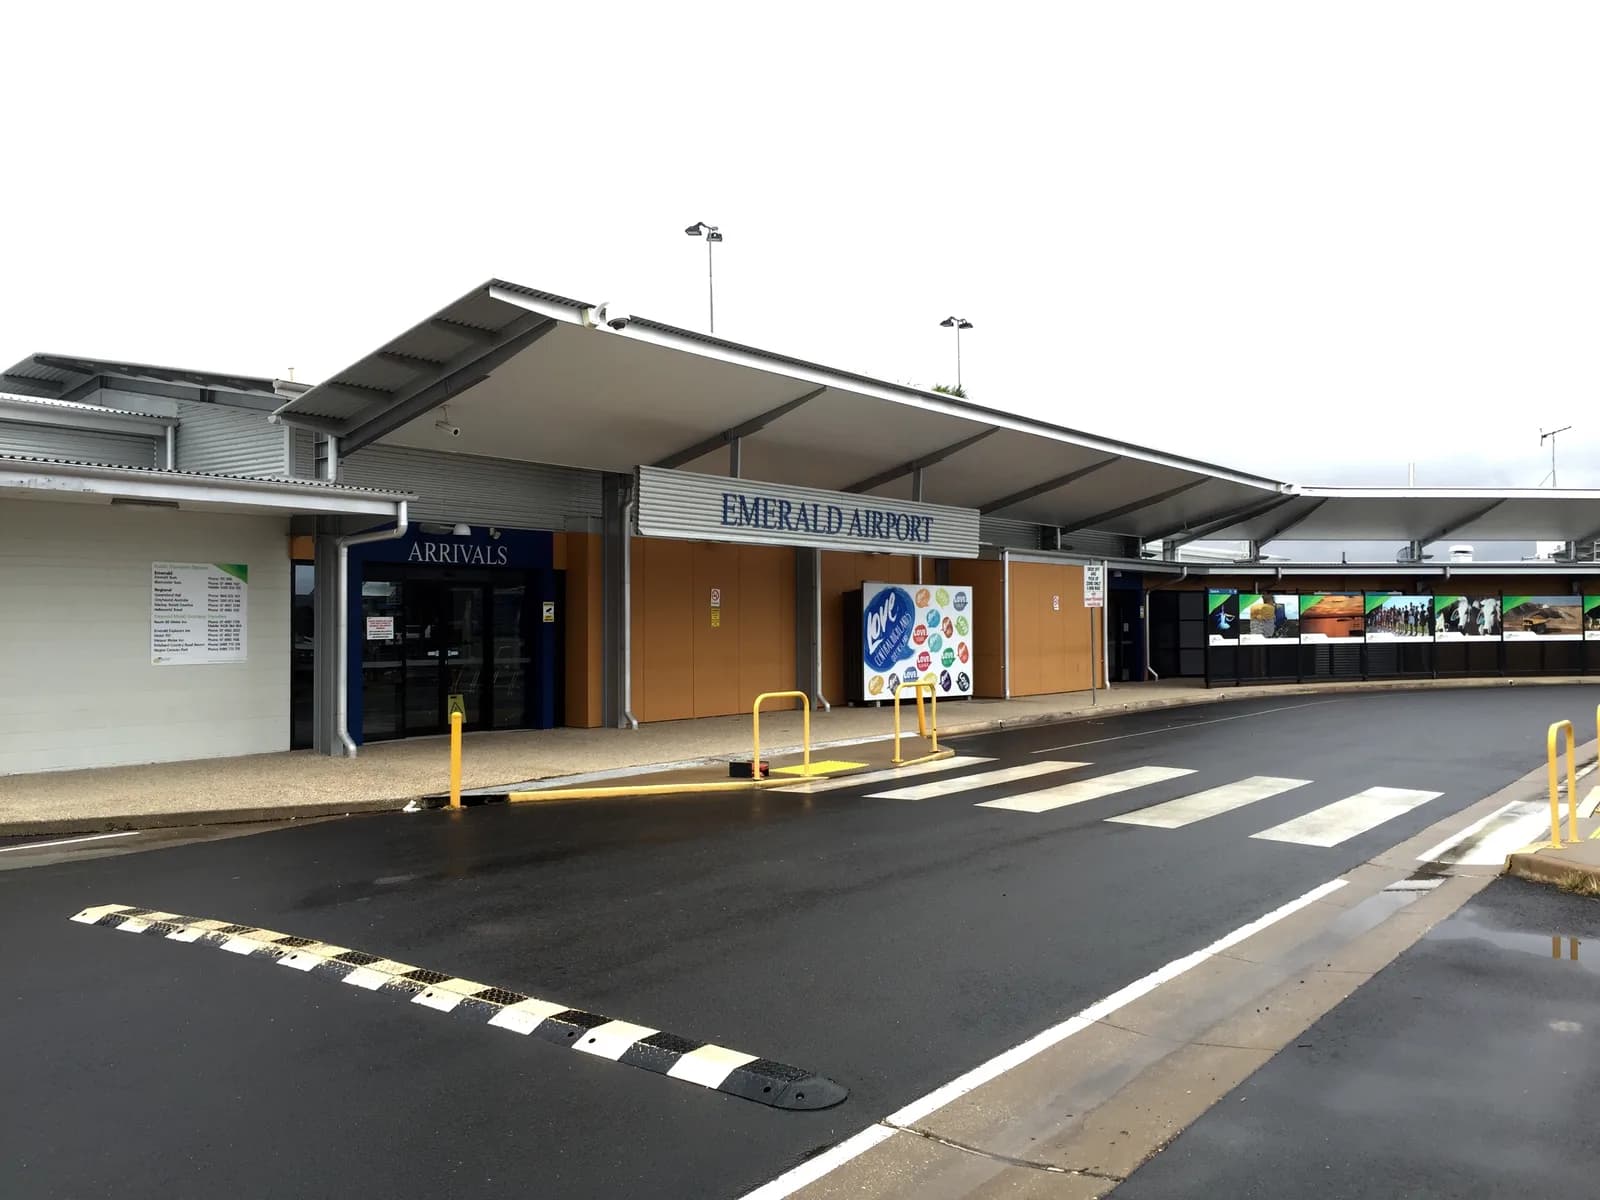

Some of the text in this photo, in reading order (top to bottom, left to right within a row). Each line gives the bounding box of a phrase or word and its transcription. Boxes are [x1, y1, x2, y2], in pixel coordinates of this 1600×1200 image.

[721, 492, 934, 543] EMERALD AIRPORT
[407, 541, 508, 566] ARRIVALS
